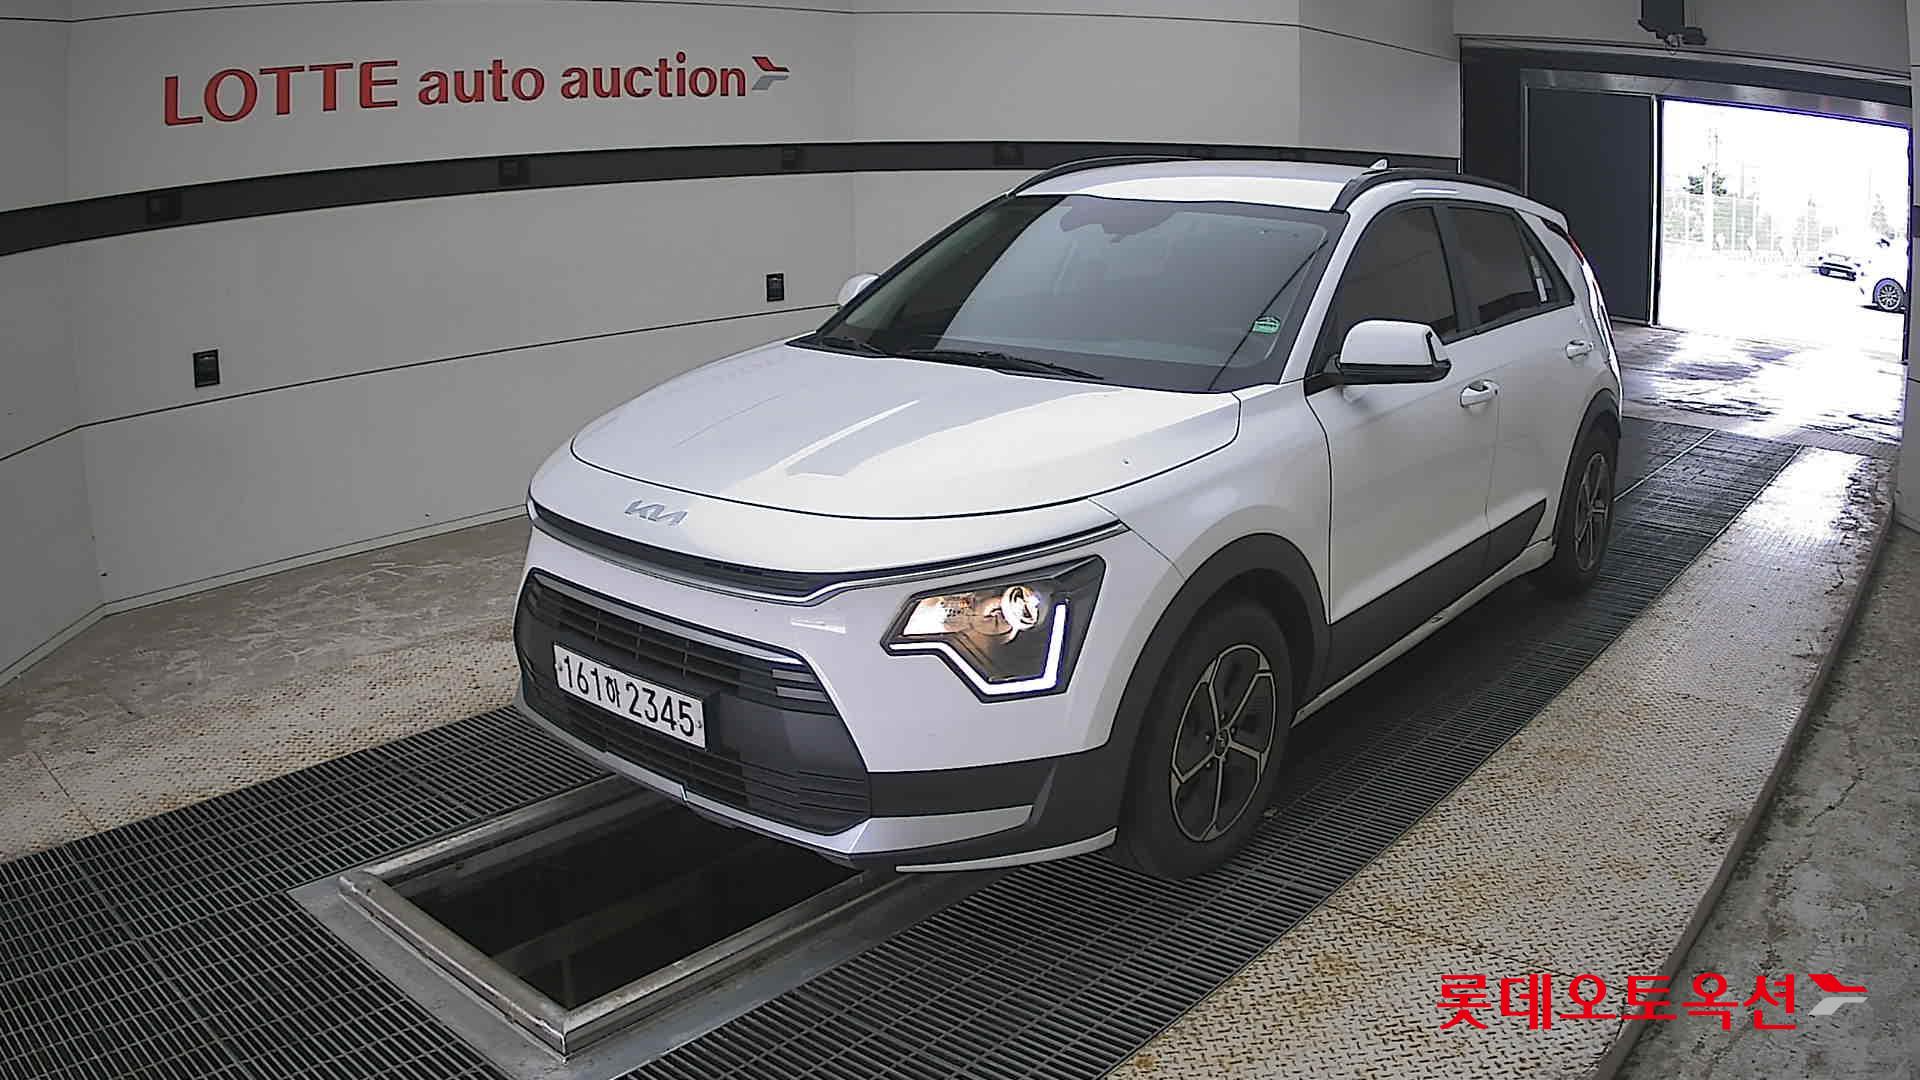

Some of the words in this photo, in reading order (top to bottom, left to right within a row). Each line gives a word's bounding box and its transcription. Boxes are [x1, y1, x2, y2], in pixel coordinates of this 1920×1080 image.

[164, 59, 398, 126] LOTTE
[417, 58, 545, 105] auto
[560, 51, 747, 100] auction
[624, 499, 688, 527] KIA
[625, 681, 695, 737] 2345
